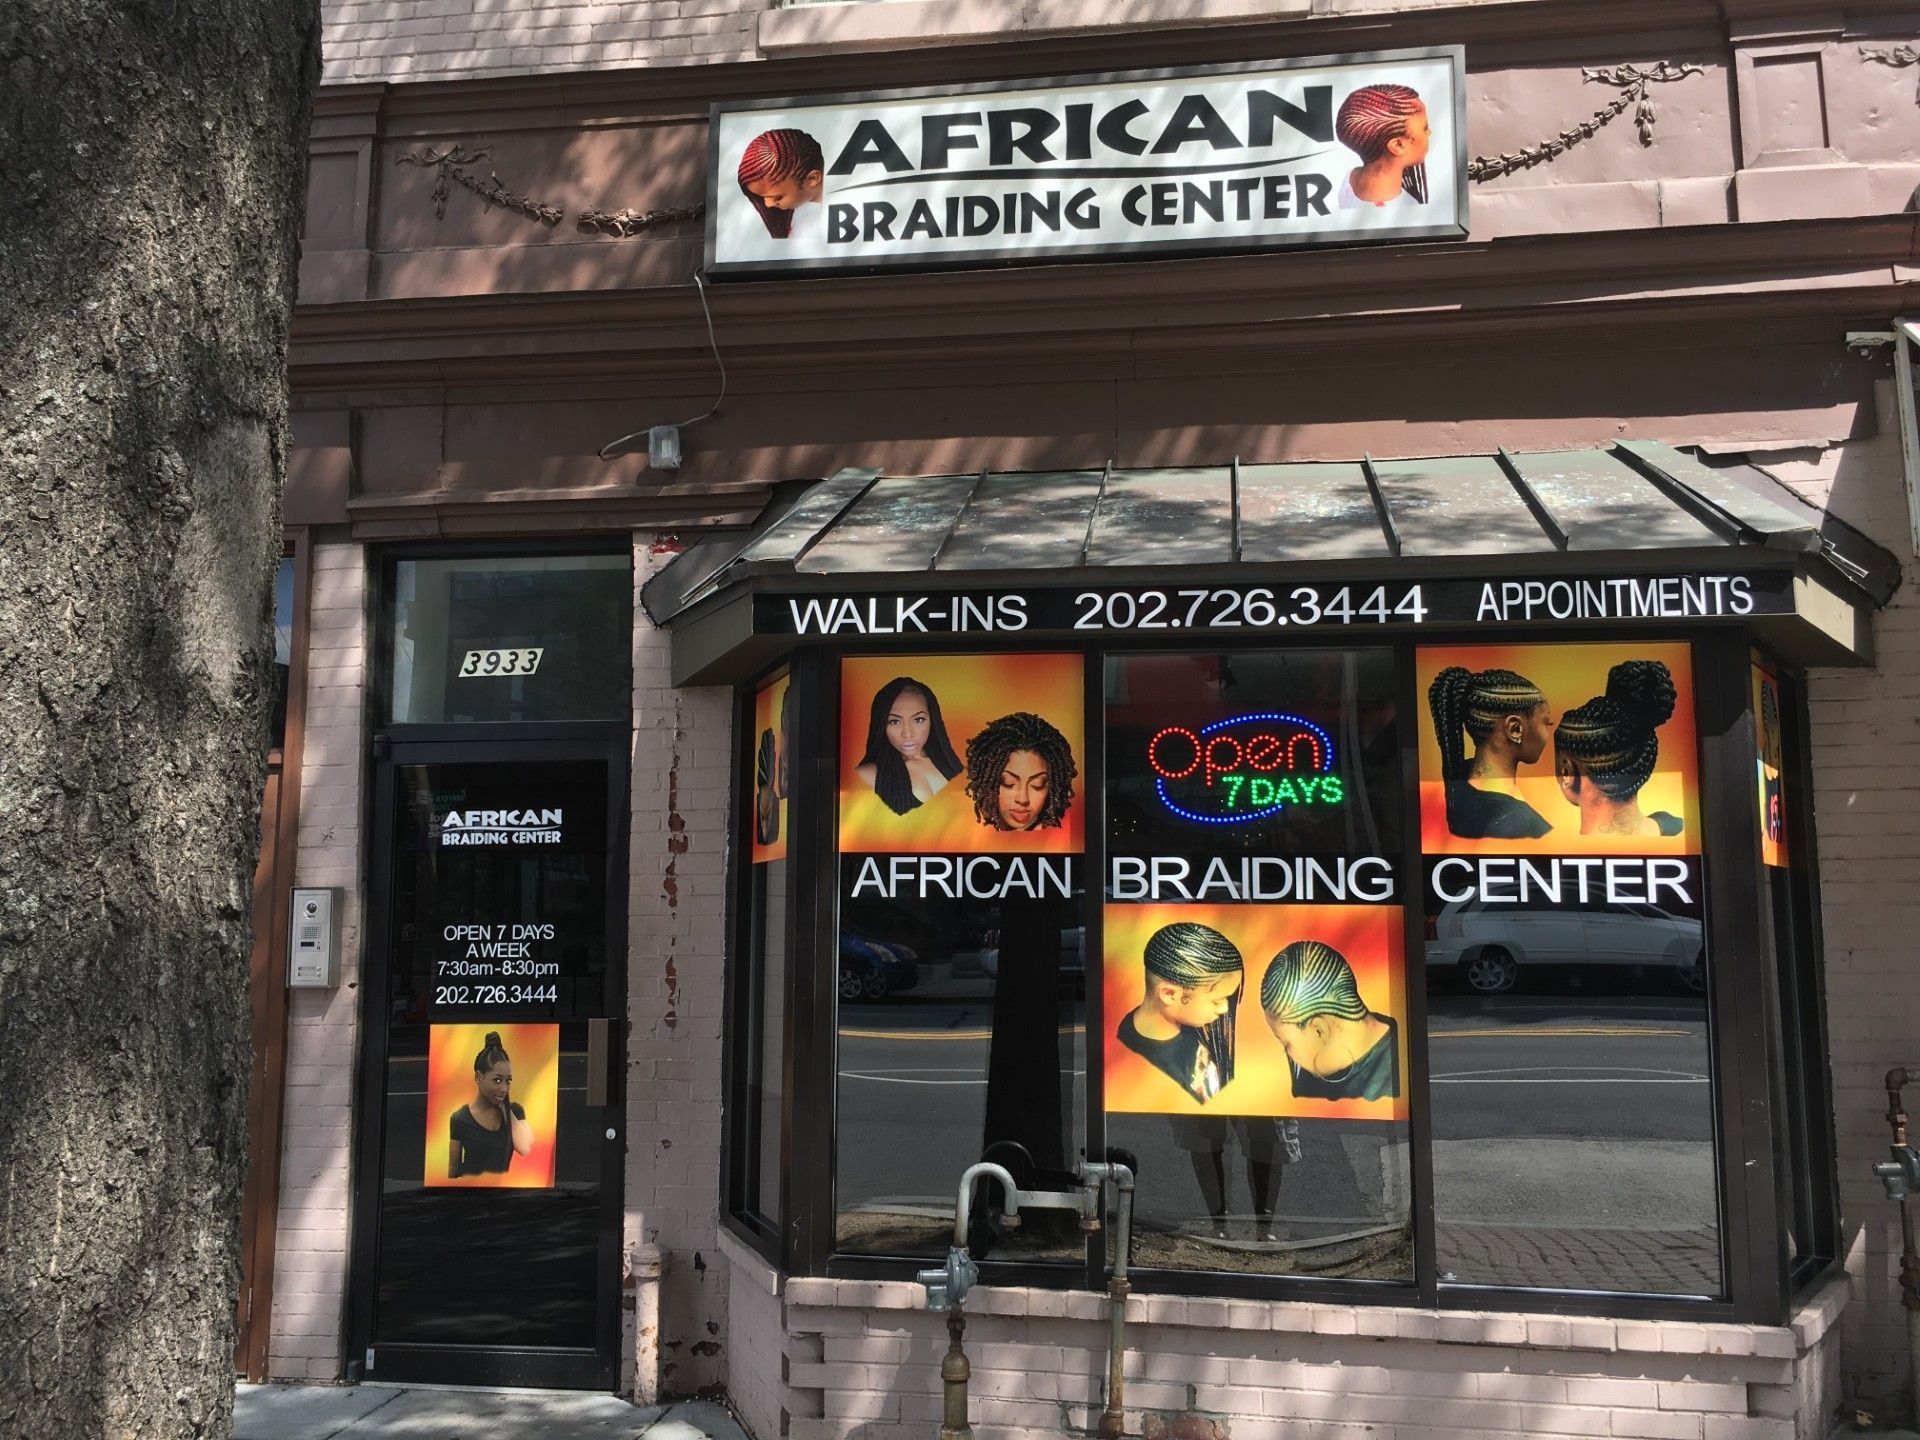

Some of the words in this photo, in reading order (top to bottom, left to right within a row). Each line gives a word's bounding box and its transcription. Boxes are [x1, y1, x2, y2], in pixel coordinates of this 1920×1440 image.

[827, 84, 1333, 175] AFRICAN
[827, 187, 1100, 243] BRAIDING
[1121, 173, 1332, 227] CENTER
[790, 594, 1028, 635] WALK-INS
[1073, 585, 1428, 631] 202.726.3444
[1477, 576, 1754, 622] APPOINTMENTS
[464, 650, 538, 675] 3933
[1148, 727, 1322, 788] Open
[1222, 776, 1245, 808] 7
[1251, 775, 1343, 808] DAYS
[442, 808, 563, 827] AFRICAN
[442, 832, 508, 845] BRAIDING
[512, 831, 562, 844] CENTER
[851, 856, 1072, 900] AFRICAN
[1112, 856, 1395, 901] BRAIDING
[1431, 857, 1693, 904] CENTER
[443, 925, 491, 941] OPEN
[497, 925, 507, 940] 7
[512, 924, 555, 940] DAYS
[437, 960, 559, 978] 7:30am-8:30pm
[435, 985, 558, 1004] 202.726.3444
